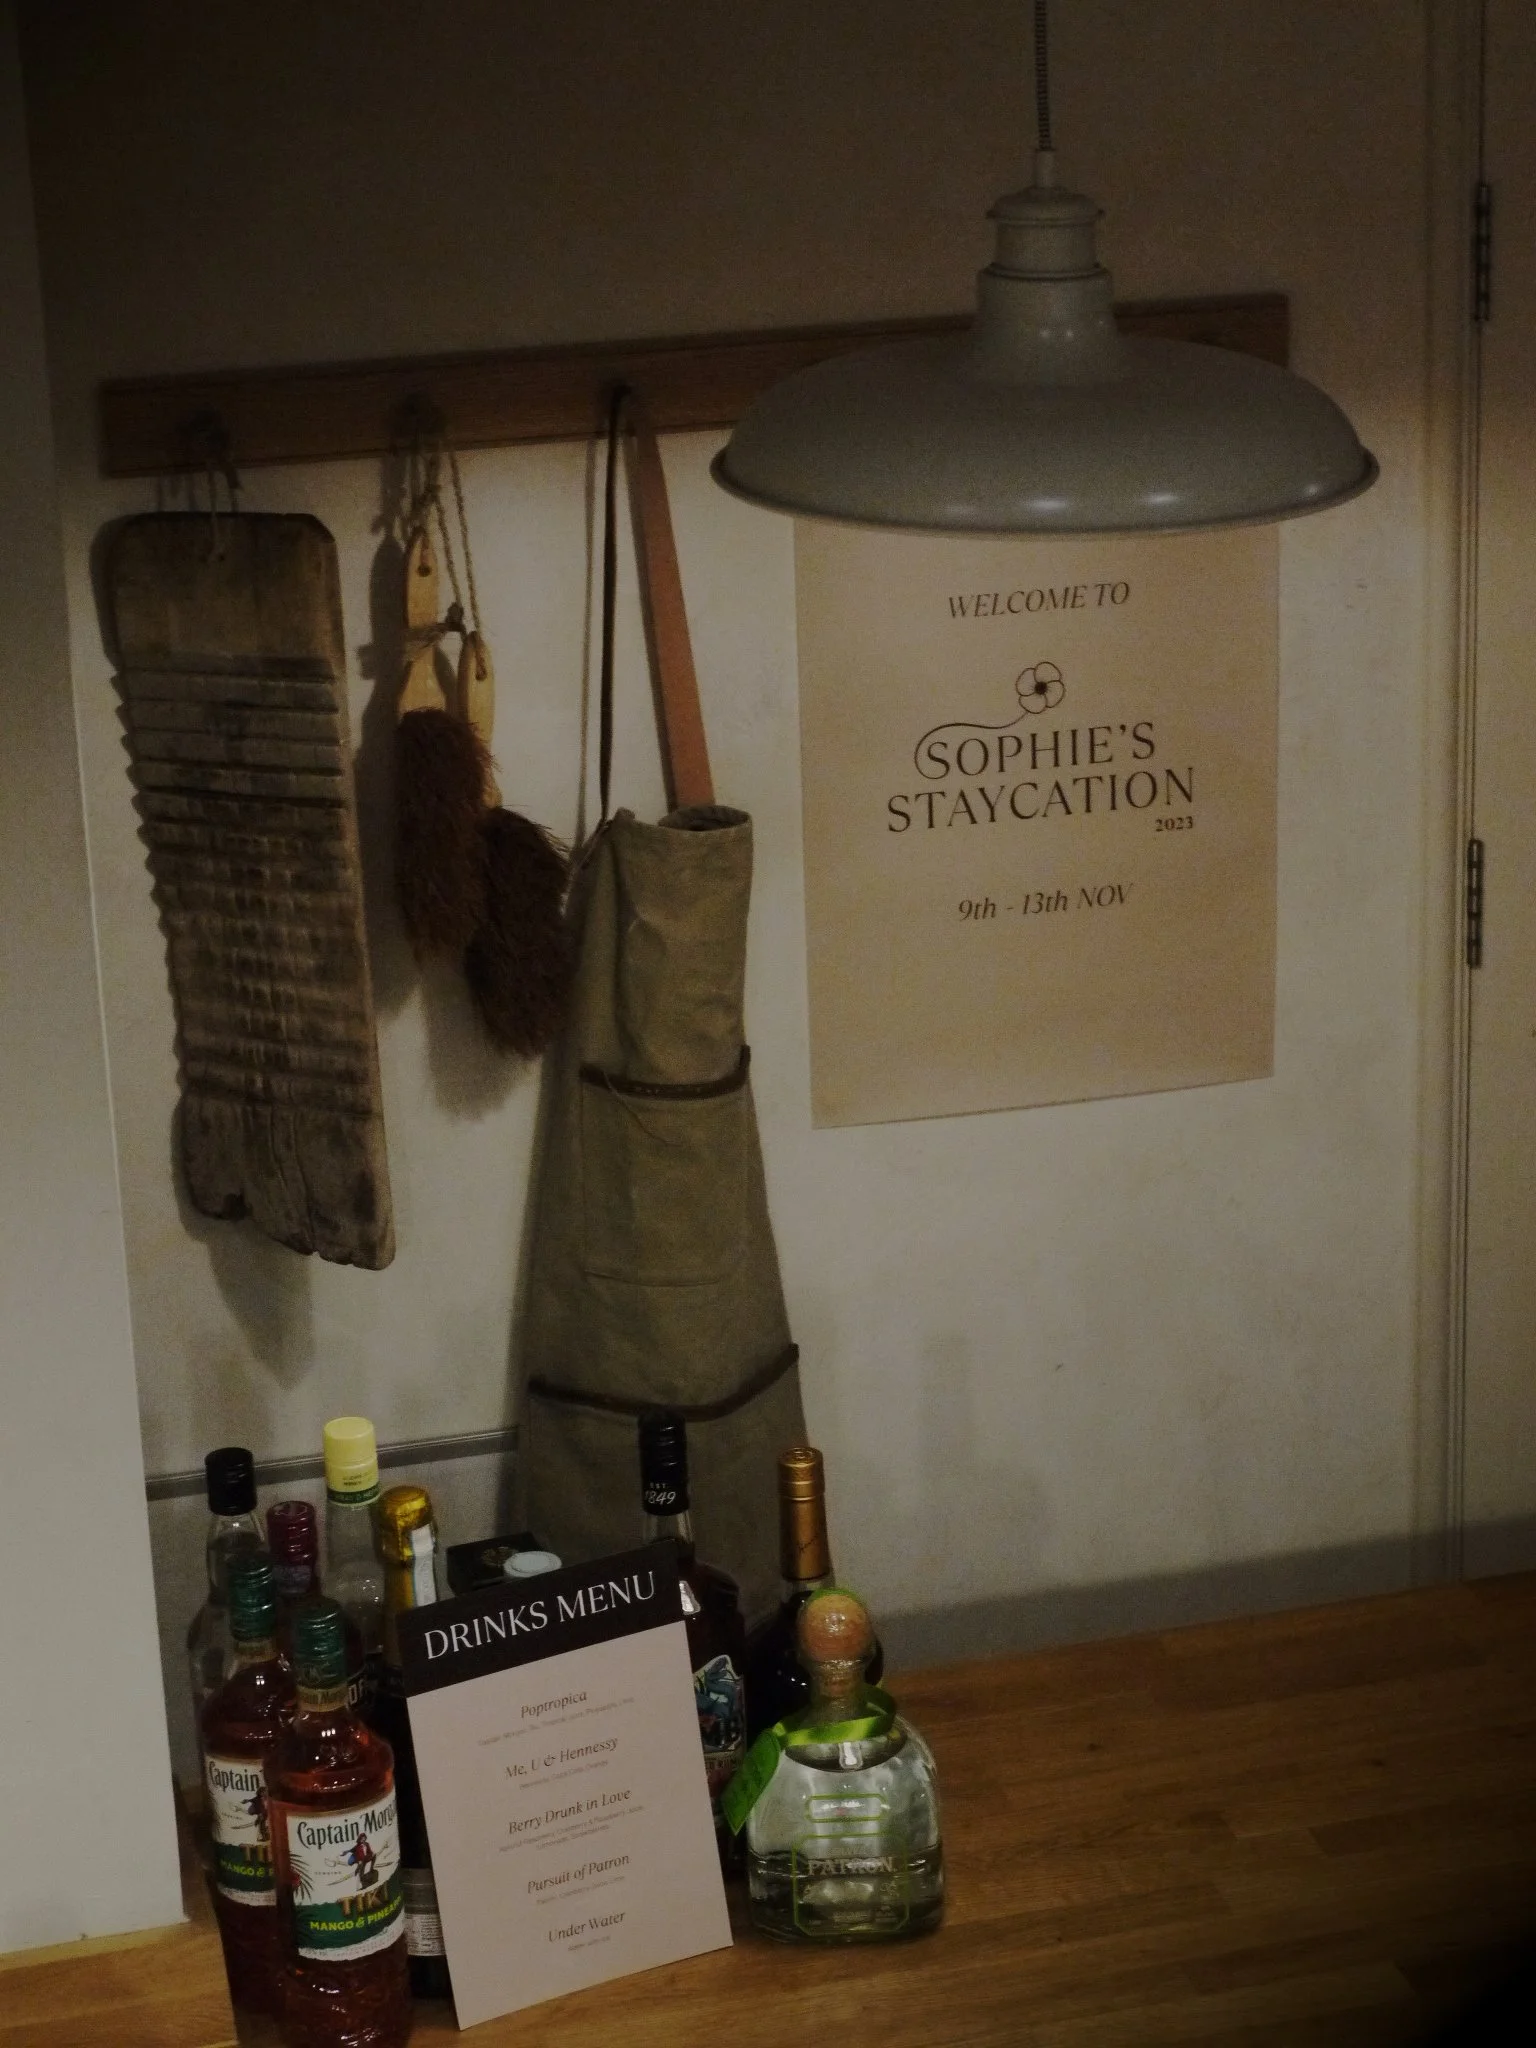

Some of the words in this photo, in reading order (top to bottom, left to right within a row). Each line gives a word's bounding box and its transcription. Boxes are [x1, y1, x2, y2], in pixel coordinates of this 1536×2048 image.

[948, 585, 1089, 618] WELCOME
[1094, 581, 1131, 607] TO
[914, 721, 1156, 780] SOPHIE'S
[887, 767, 1195, 833] STAYCATION
[1154, 815, 1195, 832] 2023
[957, 897, 997, 922] 9th
[1022, 890, 1068, 915] 13th
[1076, 882, 1134, 910] NOV
[423, 1600, 549, 1661] DRINKS
[556, 1571, 656, 1623] MENU
[520, 1691, 588, 1719] Poptropica
[559, 1736, 619, 1763] Hennessy
[209, 1760, 259, 1792] Captain
[508, 1816, 542, 1835] Berry
[544, 1801, 583, 1824] Drunk
[586, 1799, 598, 1812] in
[601, 1789, 632, 1807] Love
[297, 1818, 359, 1851] Captain
[527, 1871, 570, 1894] Pursuit
[573, 1863, 586, 1881] of
[588, 1854, 630, 1876] Patron
[310, 1919, 355, 1931] MANGO
[548, 1922, 586, 1942] Under
[588, 1911, 626, 1930] Water
